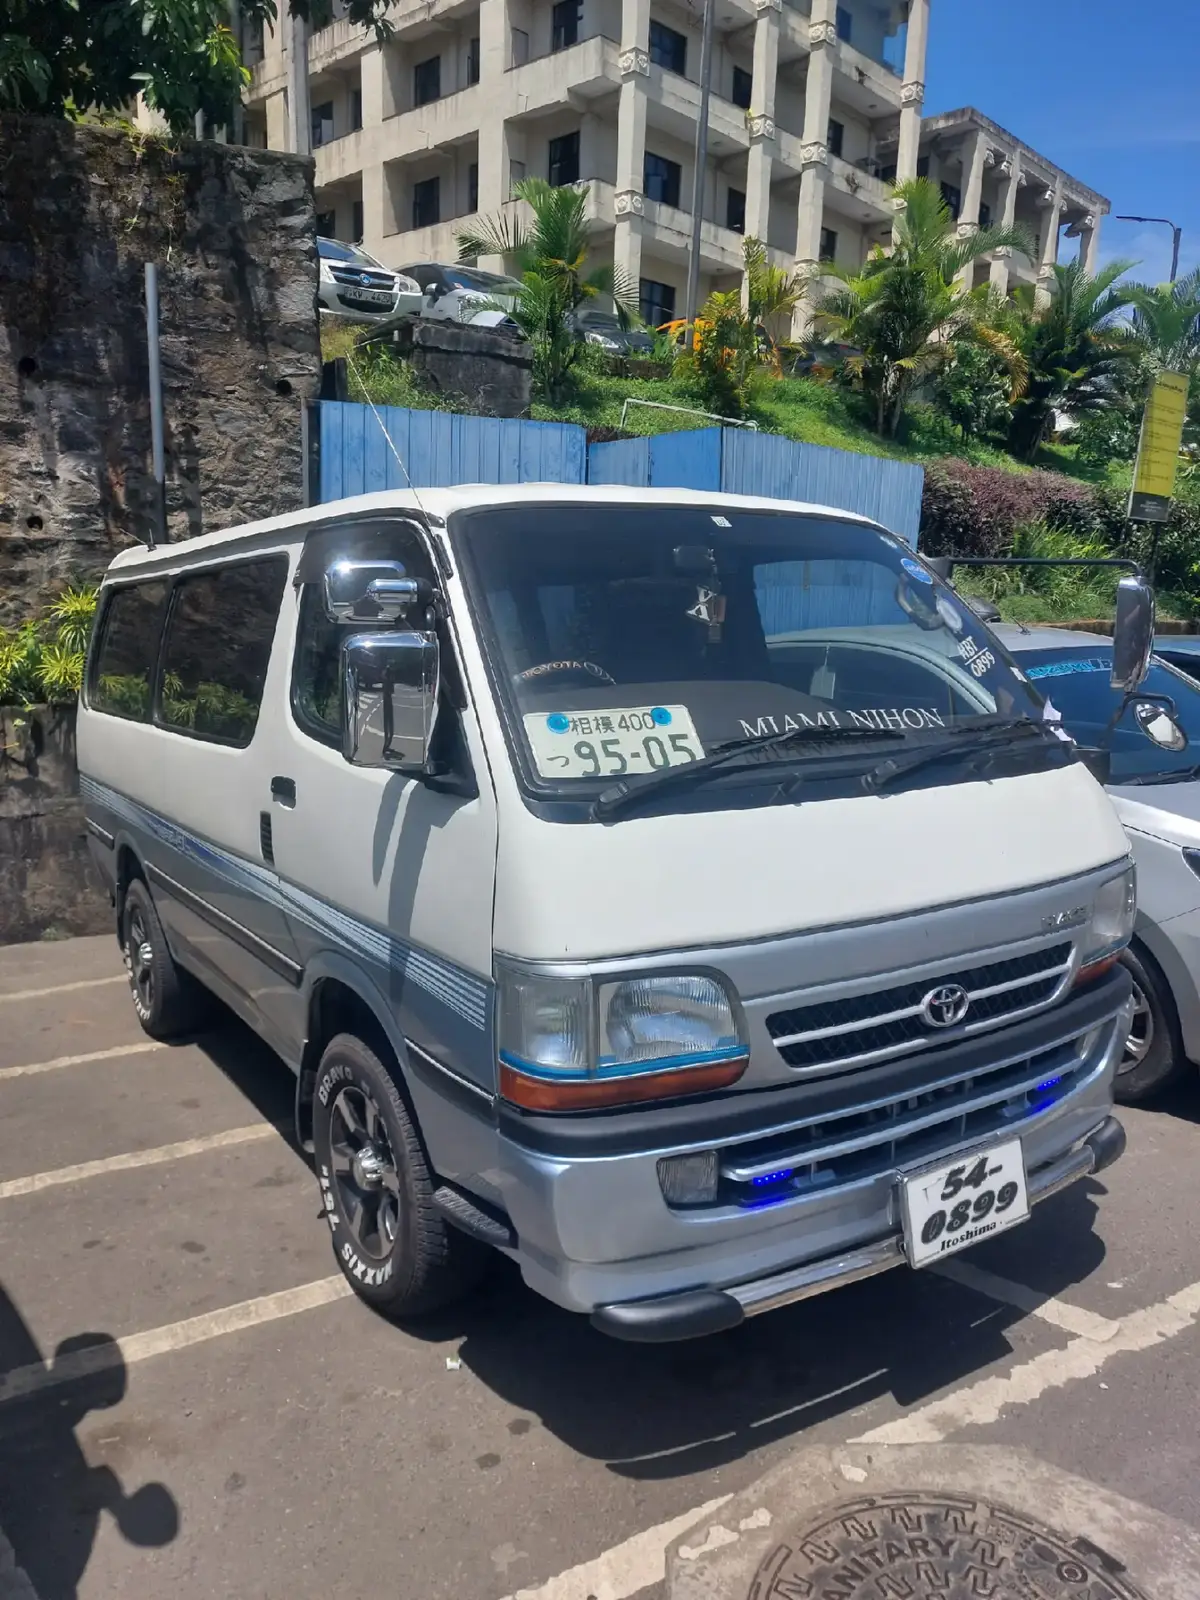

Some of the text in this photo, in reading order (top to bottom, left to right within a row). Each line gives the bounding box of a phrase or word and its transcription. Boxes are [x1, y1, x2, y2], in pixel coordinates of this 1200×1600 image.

[957, 635, 978, 660] HBT
[970, 651, 995, 677] 0899
[521, 661, 582, 678] TOYOTA
[737, 708, 946, 738] MIAMI NIHON
[574, 733, 697, 776] 95-05
[318, 1064, 353, 1107] BRAVO
[921, 1181, 1019, 1245] 0899
[940, 1221, 997, 1252] Itoshima
[341, 1243, 393, 1286] MAXXIS
[821, 1538, 957, 1600] ANITARY
